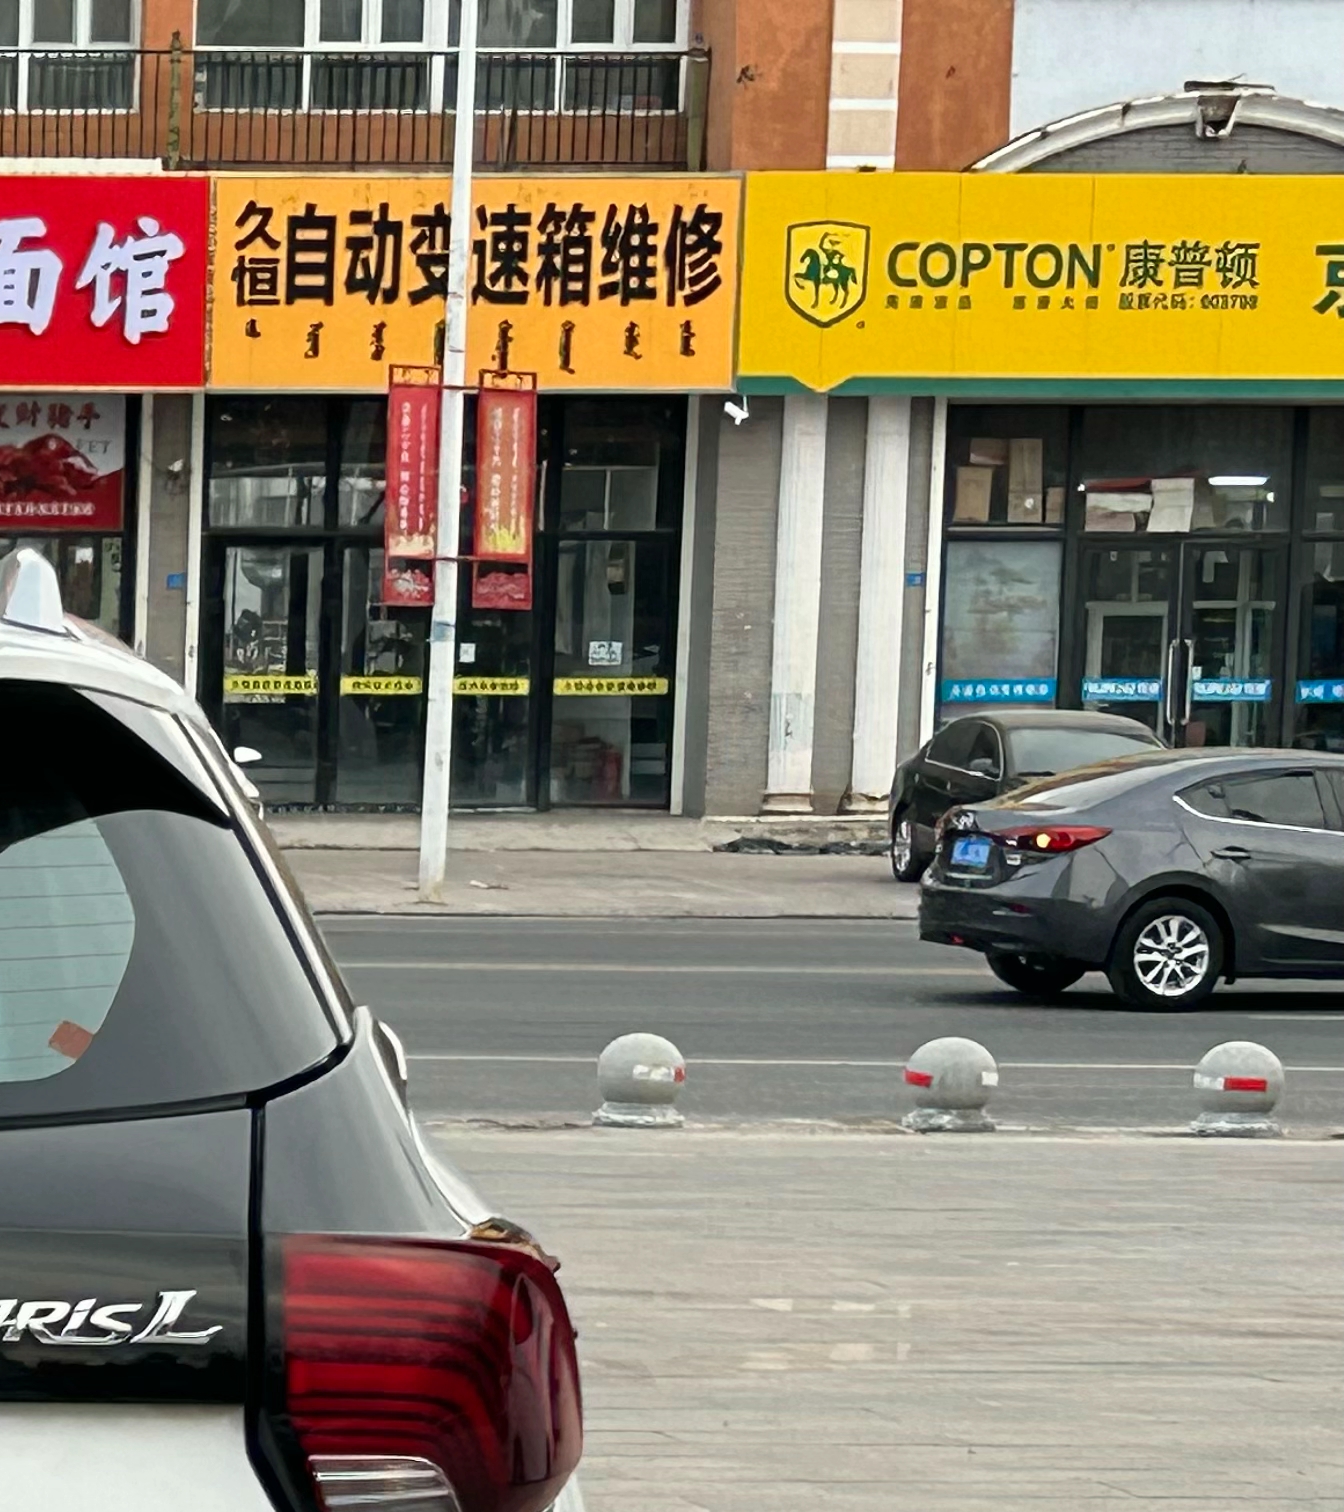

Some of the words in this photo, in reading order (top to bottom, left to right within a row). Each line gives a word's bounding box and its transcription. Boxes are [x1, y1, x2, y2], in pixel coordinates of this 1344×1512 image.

[231, 200, 281, 306] 久恒
[285, 203, 724, 307] 自动变速箱维修
[887, 242, 1102, 288] COPTON
[1119, 239, 1261, 289] 康普顿
